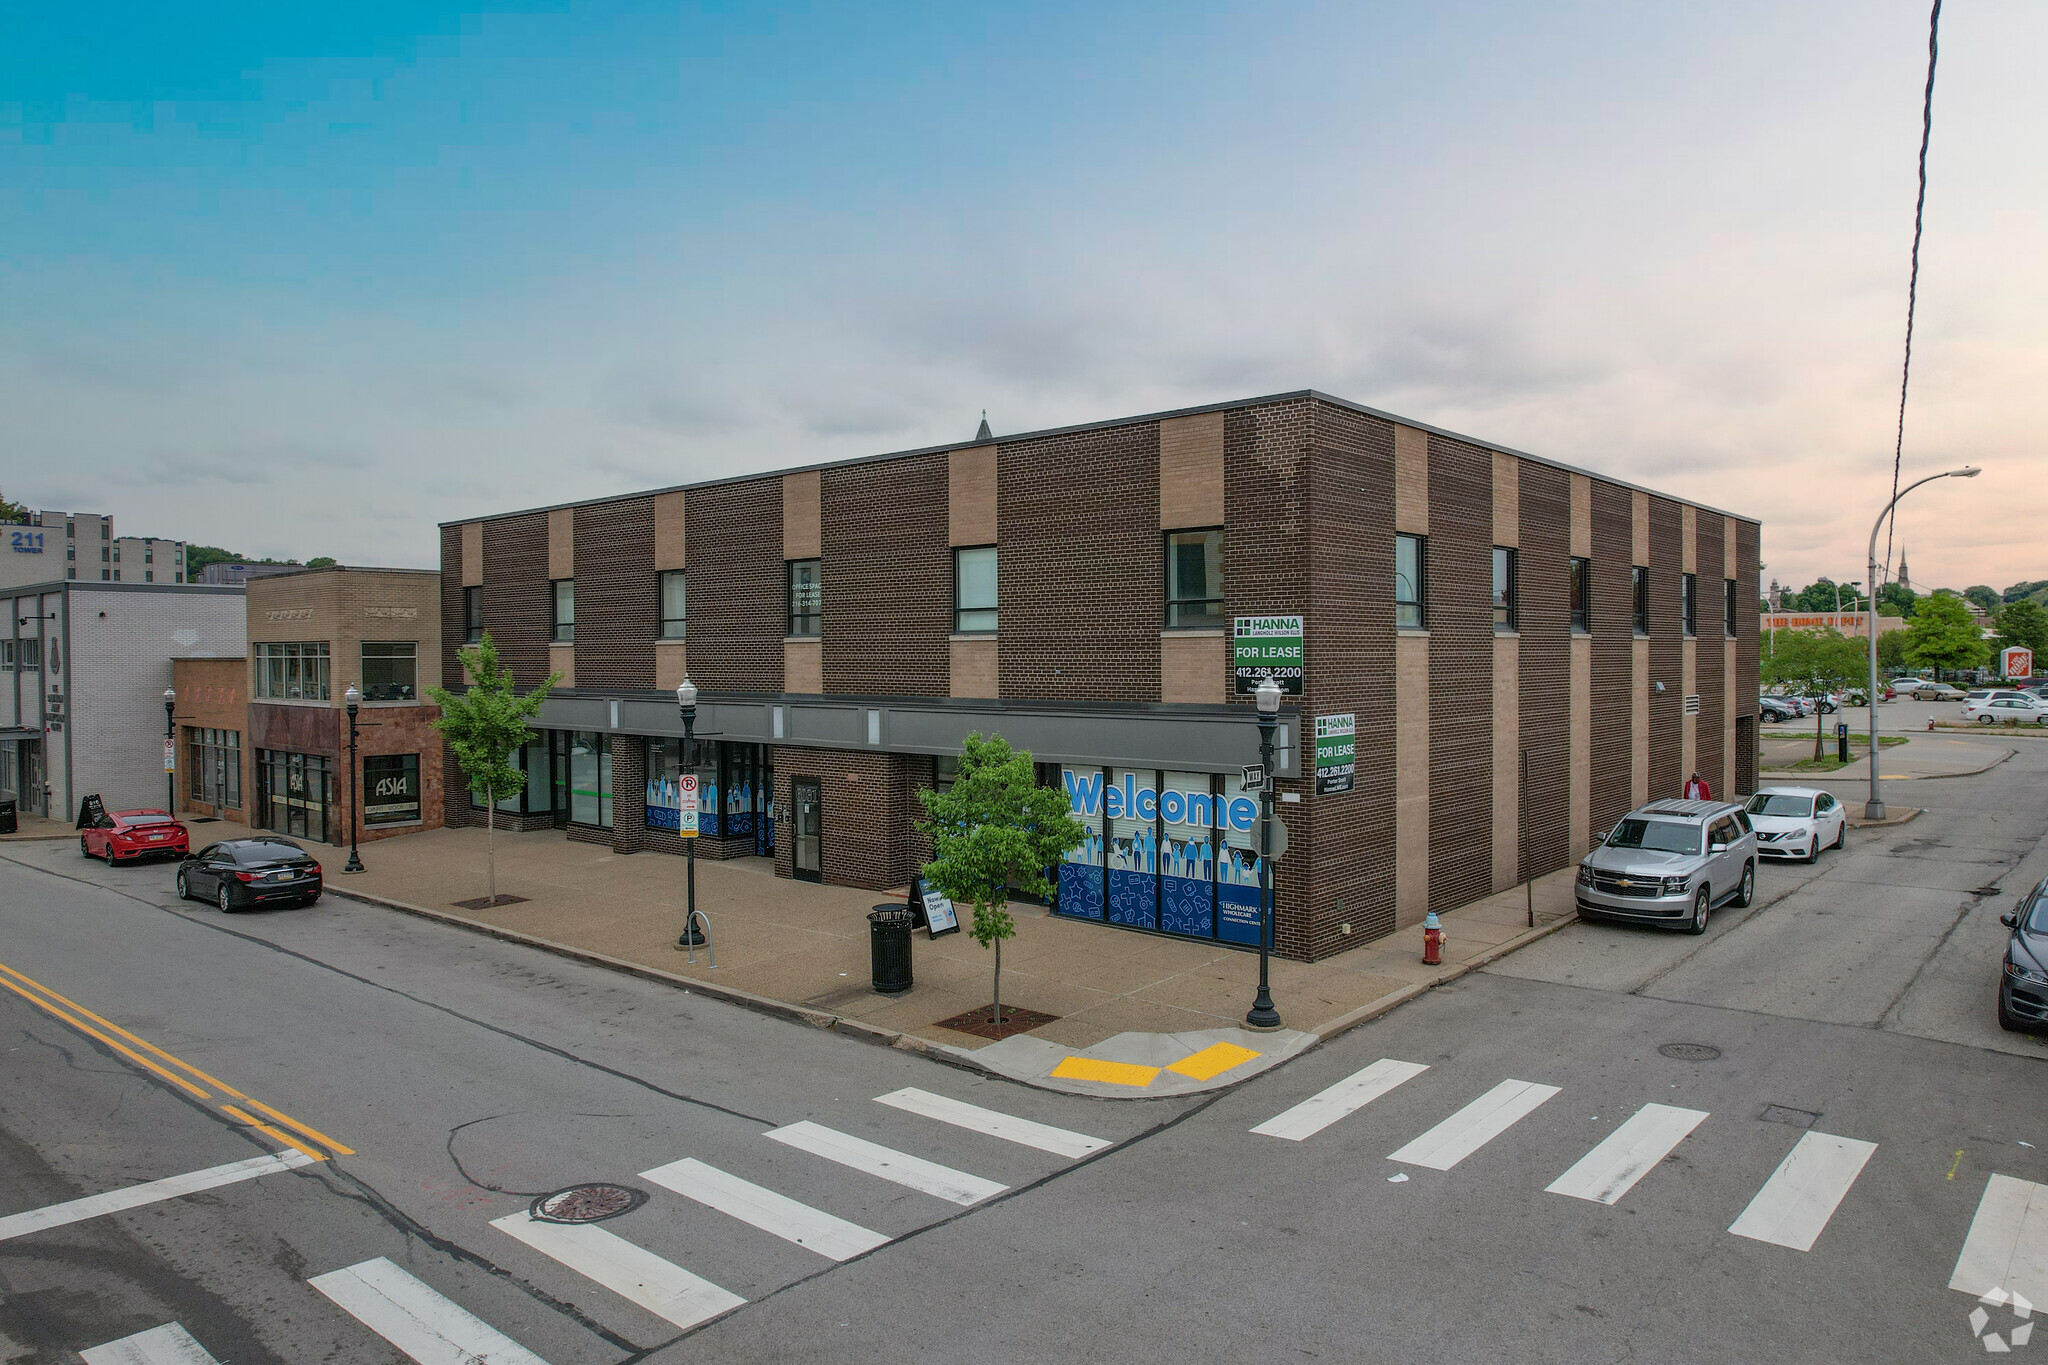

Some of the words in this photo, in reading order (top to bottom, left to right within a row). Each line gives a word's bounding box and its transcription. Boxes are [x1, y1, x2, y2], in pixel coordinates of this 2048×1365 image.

[11, 531, 44, 547] 211
[1253, 618, 1300, 630] HANNA
[1766, 618, 1788, 627] THE
[1792, 618, 1823, 627] HOME
[1236, 647, 1259, 658] FOR
[1262, 646, 1301, 658] LEASE
[2009, 653, 2029, 676] HOME
[1236, 667, 1301, 678] 412.26.2200
[1327, 716, 1353, 729] HANNA
[1318, 747, 1333, 758] FOR
[1334, 743, 1355, 757] LEASE
[1317, 763, 1355, 779] 412.261.2200
[290, 774, 303, 791] ASIA
[375, 776, 407, 796] ASIA
[1062, 769, 1259, 833] Welcome
[929, 903, 944, 911] Open
[1222, 902, 1258, 913] HIGHMARK
[1223, 910, 1252, 918] WHOLECARE
